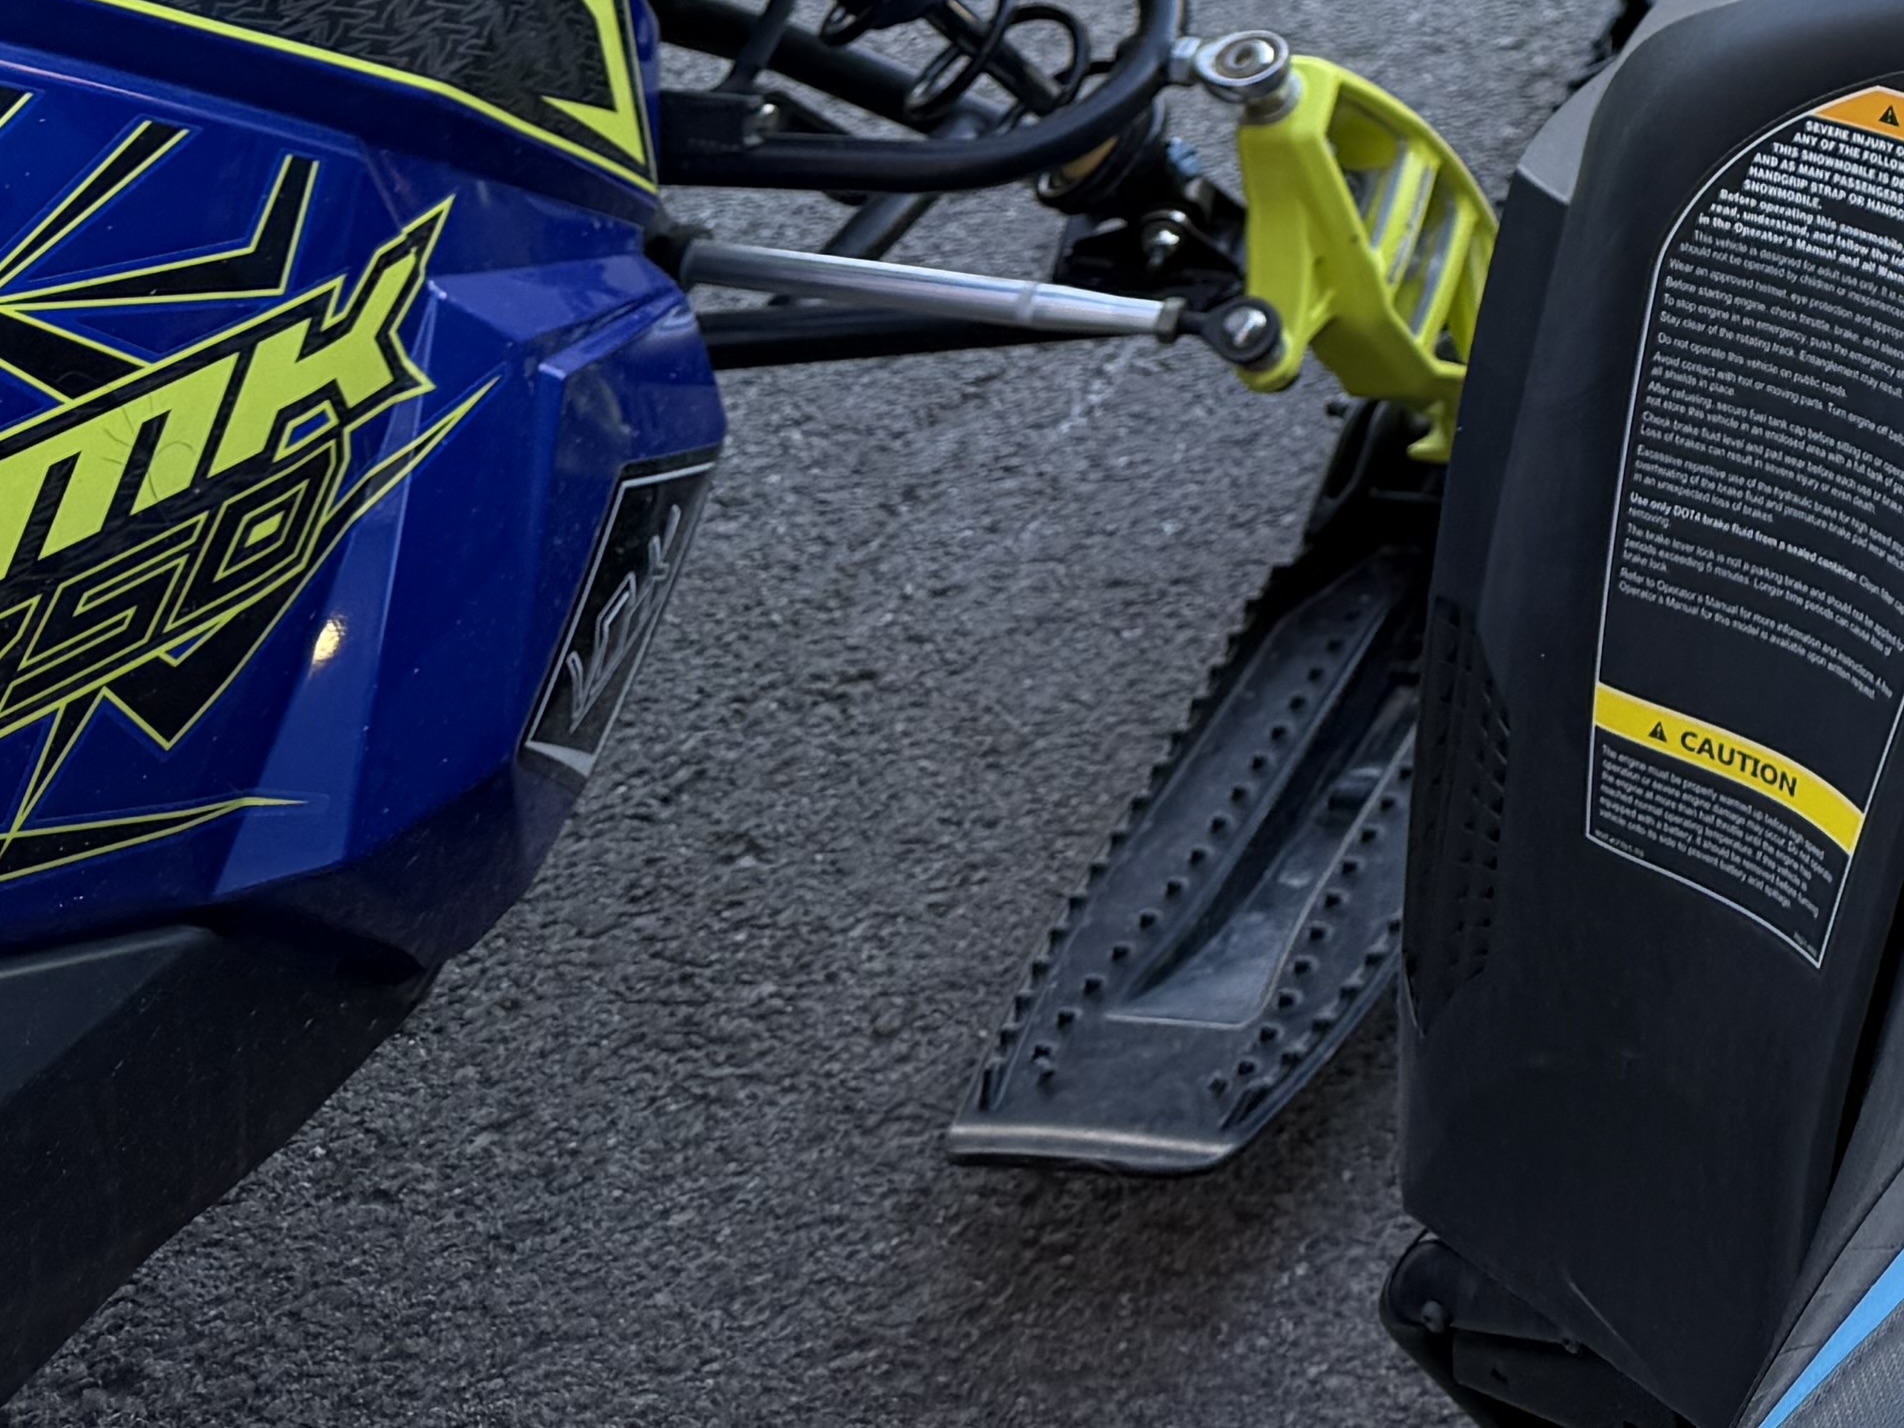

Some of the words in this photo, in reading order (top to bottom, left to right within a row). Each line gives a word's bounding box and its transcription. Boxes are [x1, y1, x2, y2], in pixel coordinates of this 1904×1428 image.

[1792, 132, 1818, 145] ANY
[1821, 139, 1834, 151] OF
[1838, 143, 1860, 158] THE
[1805, 120, 1850, 140] SEVERE
[1852, 132, 1894, 152] INJURY
[1752, 152, 1778, 166] AND
[1779, 159, 1796, 172] AS
[1798, 164, 1831, 181] MANY
[1833, 173, 1904, 204] PASSENGERS
[1772, 143, 1799, 157] THIS
[1802, 150, 1877, 179] SNOWMOBILE
[1878, 173, 1889, 184] IS
[1742, 179, 1822, 210] SNOWMOBILE.
[1748, 166, 1808, 188] HANDGRIP
[1810, 182, 1846, 200] STRAP
[1849, 193, 1865, 207] OR
[1680, 730, 1798, 798] CAUTION
